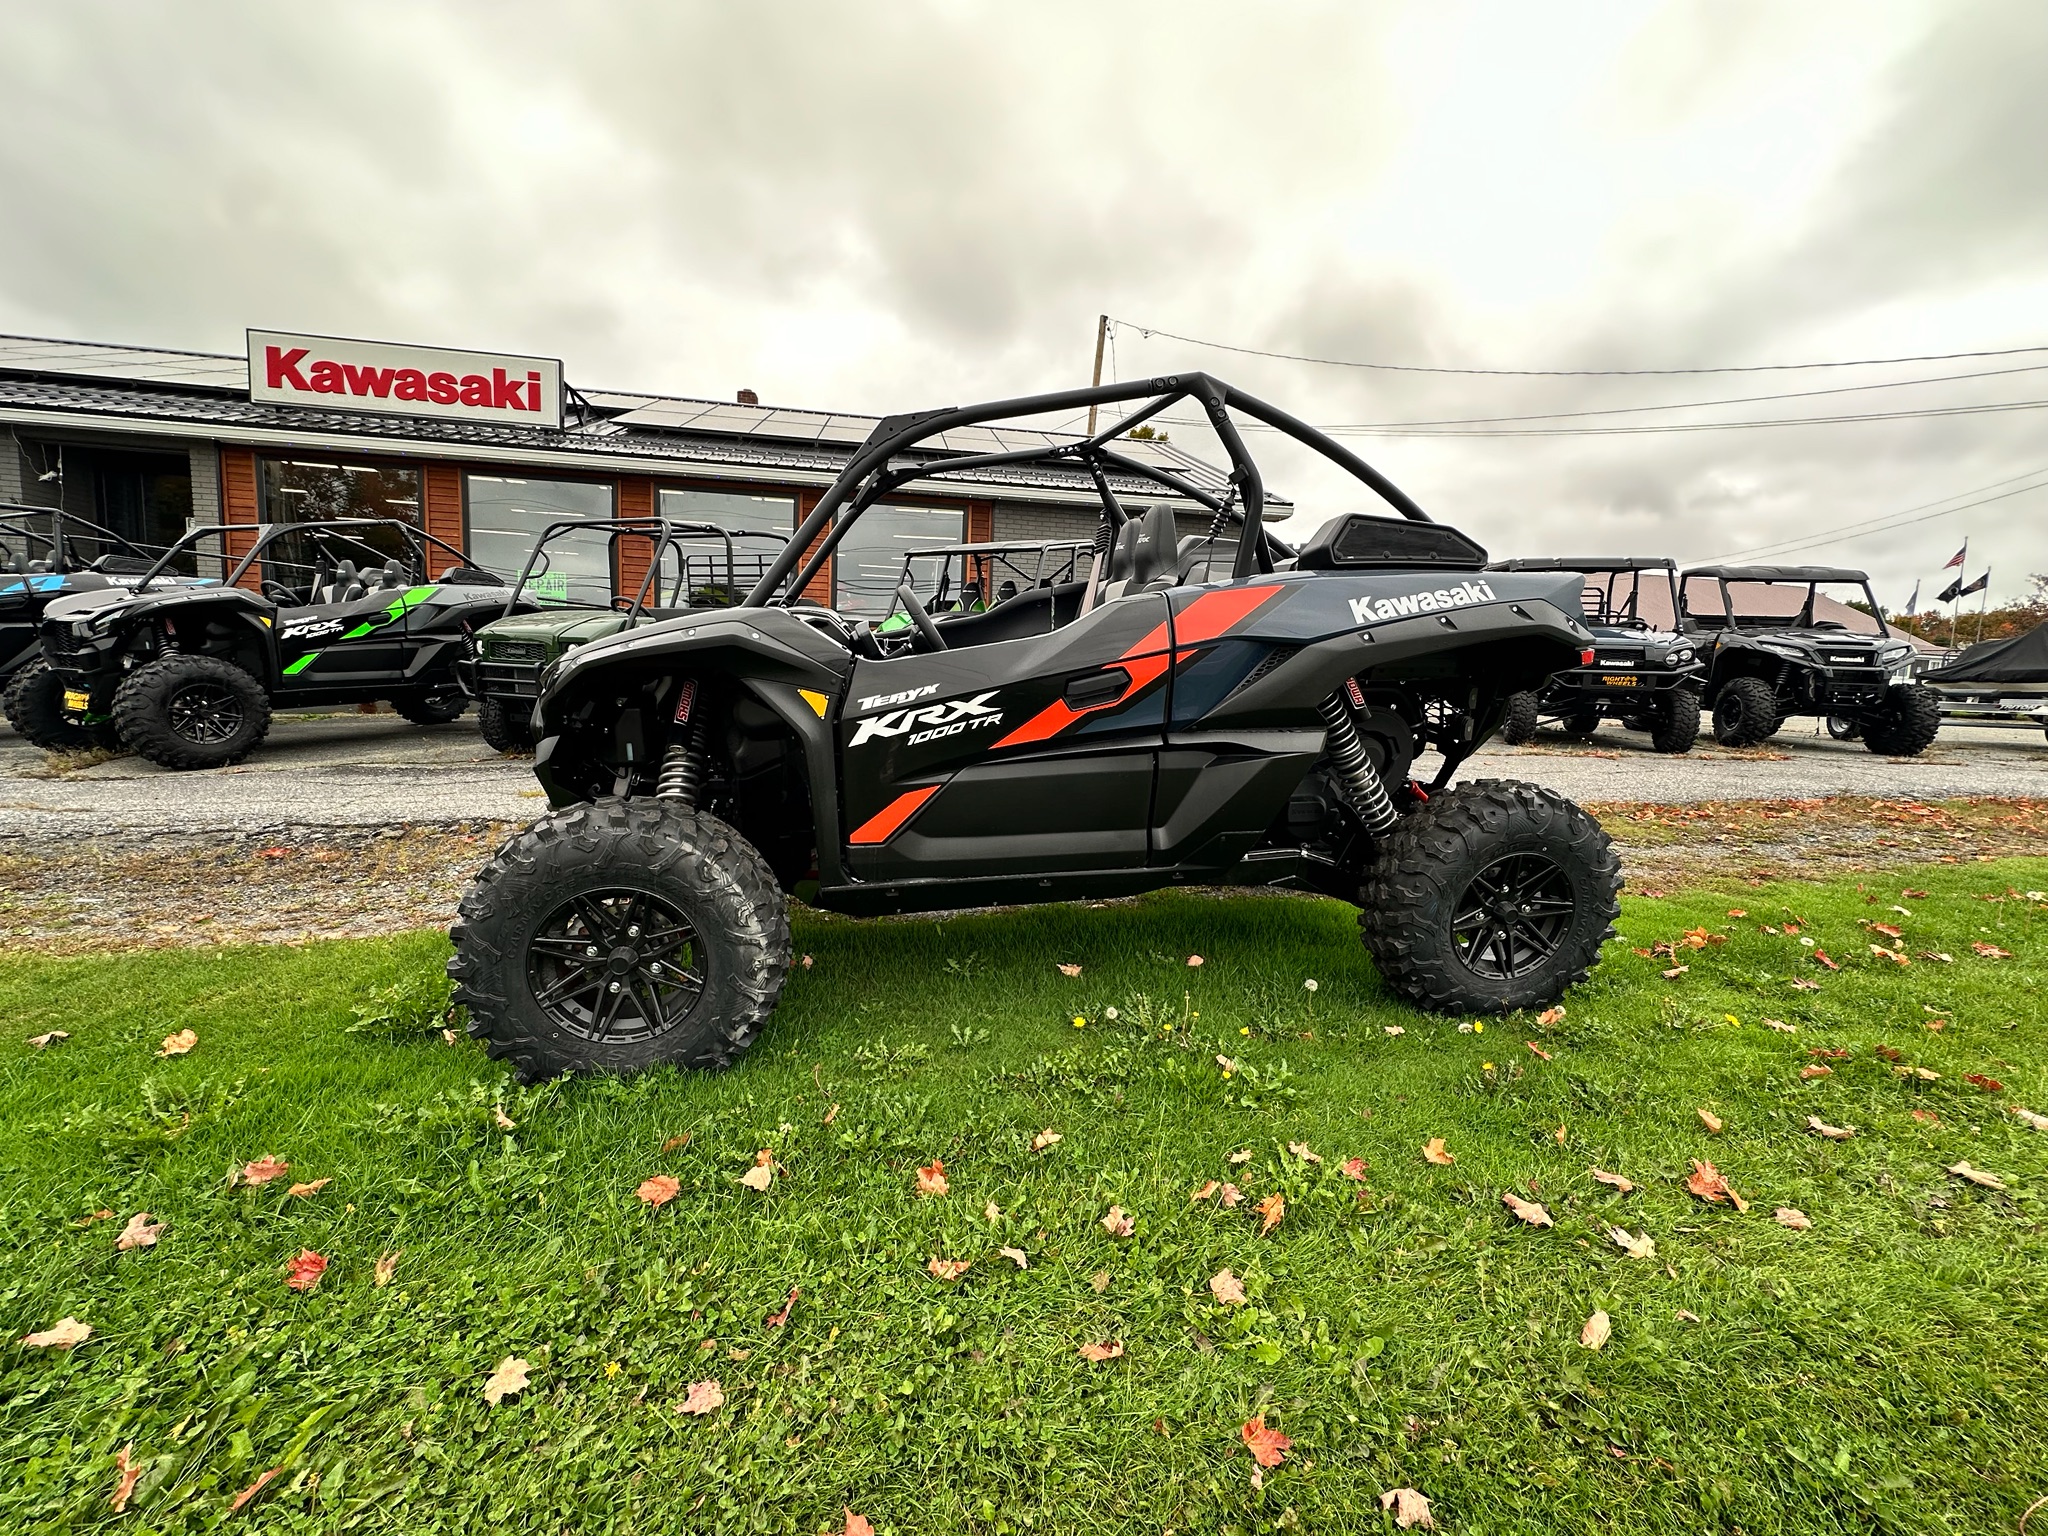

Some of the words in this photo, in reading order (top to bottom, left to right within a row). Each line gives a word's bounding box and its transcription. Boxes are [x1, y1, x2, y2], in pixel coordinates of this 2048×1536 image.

[266, 346, 541, 412] Kawasaki
[105, 576, 177, 585] Kawaki
[463, 589, 510, 600] Kawasaki
[1348, 579, 1497, 625] Kawasaki
[281, 618, 343, 639] KRX
[1600, 659, 1635, 667] Kawasaki
[677, 681, 695, 722] SHOWA
[848, 689, 1002, 748] KRX
[907, 721, 968, 746] 1000
[968, 713, 1004, 730] TR
